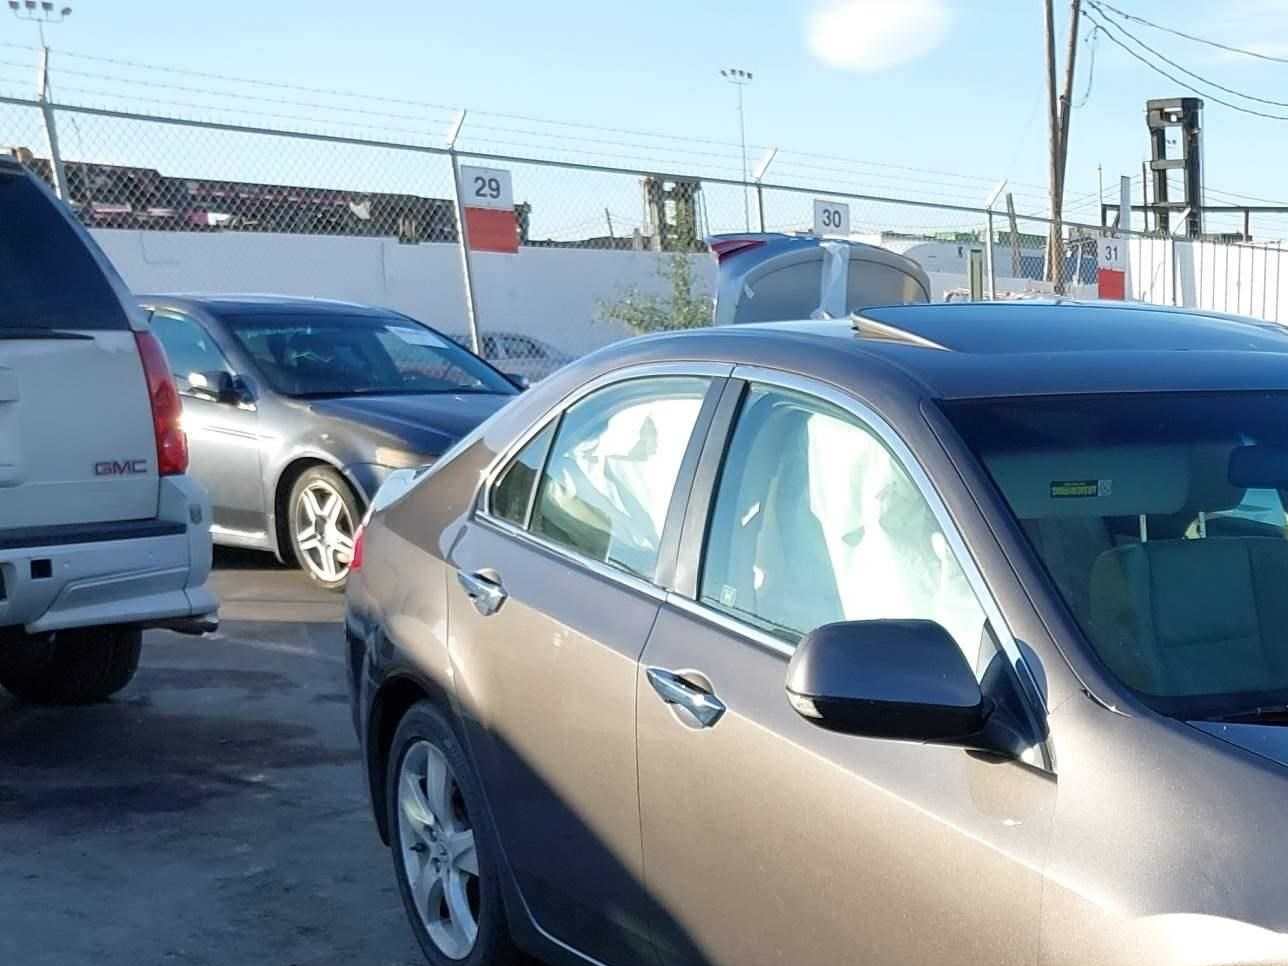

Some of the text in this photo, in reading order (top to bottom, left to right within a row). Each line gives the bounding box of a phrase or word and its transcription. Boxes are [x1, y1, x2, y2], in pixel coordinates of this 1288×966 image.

[474, 176, 501, 199] 29
[822, 209, 842, 228] 30
[1105, 246, 1118, 261] 31
[95, 460, 148, 476] GMC
